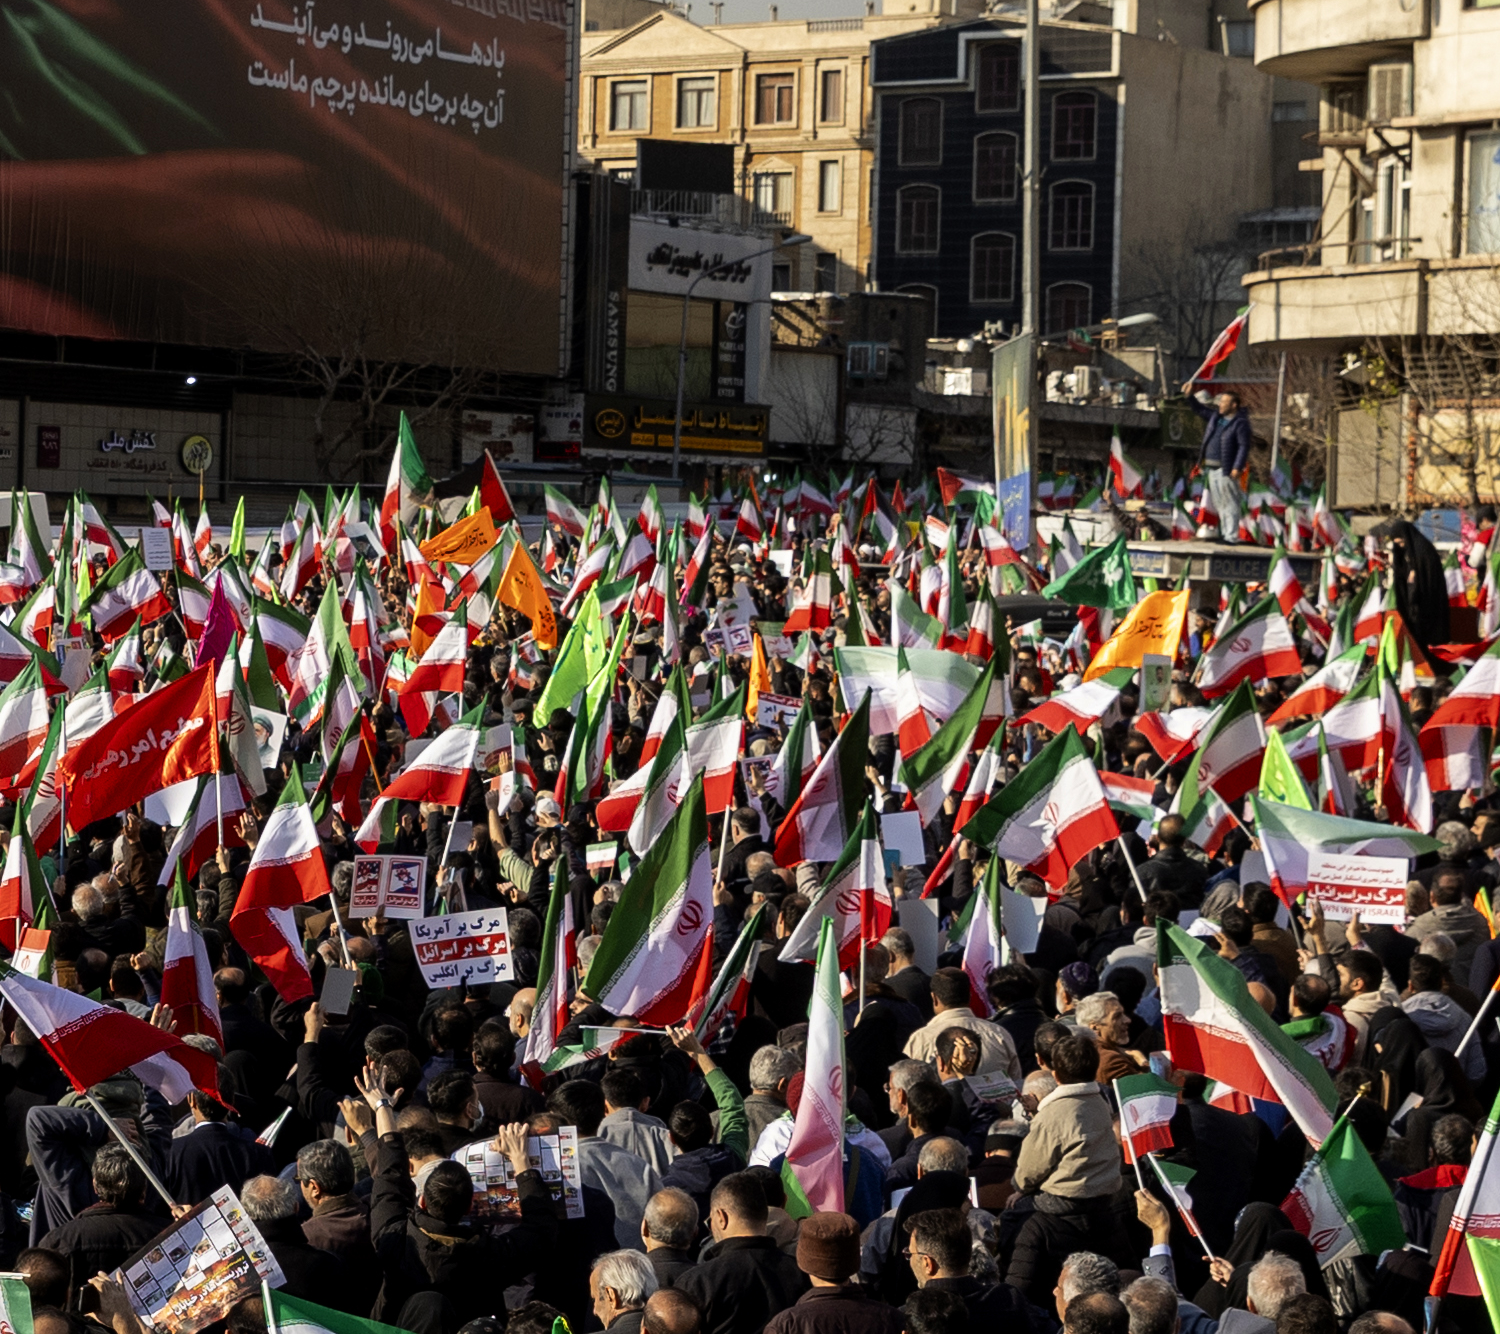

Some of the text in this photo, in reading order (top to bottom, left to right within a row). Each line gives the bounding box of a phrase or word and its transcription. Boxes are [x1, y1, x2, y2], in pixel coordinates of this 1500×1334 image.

[341, 24, 352, 54] و
[436, 27, 505, 78] بادها
[247, 58, 308, 94] ماست
[310, 77, 357, 116] پرچم
[359, 74, 407, 108] مانده
[606, 291, 620, 393] SAMSUNG
[101, 429, 157, 454] کفش ملی
[1212, 559, 1262, 575] POLICE
[1307, 884, 1404, 905] مرگ بر اسرائیل
[1367, 908, 1400, 917] ISRAEL
[415, 916, 500, 939] مرگ بر آمریکا
[420, 937, 506, 964] مرگ بر اسرائیل
[476, 961, 507, 976] مرگ
